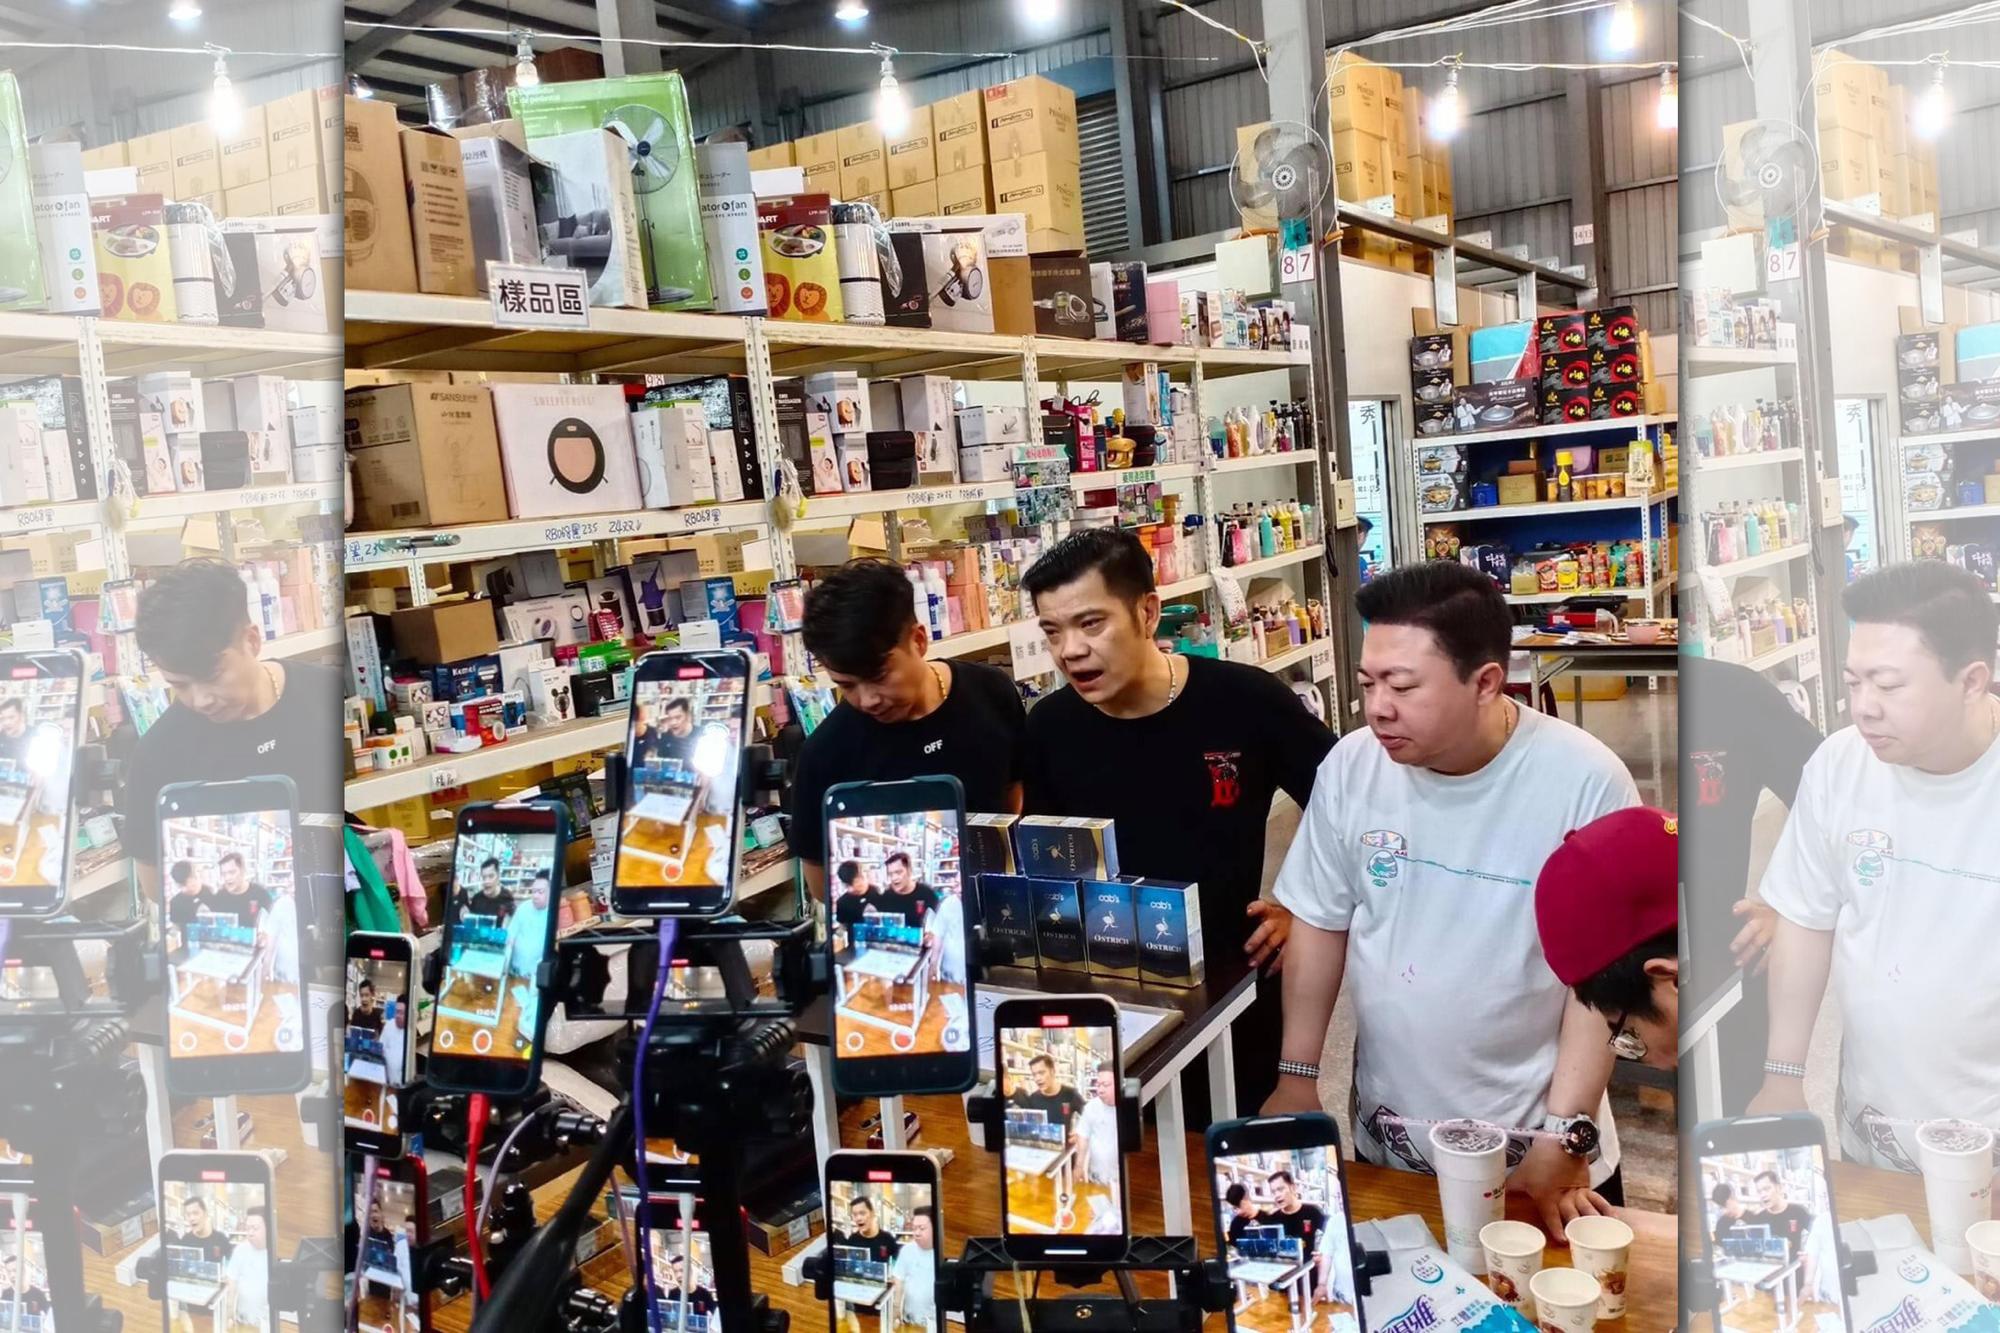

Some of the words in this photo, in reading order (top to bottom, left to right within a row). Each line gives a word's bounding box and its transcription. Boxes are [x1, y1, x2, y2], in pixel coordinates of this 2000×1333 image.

[731, 199, 747, 213] fan
[1283, 253, 1311, 275] 87
[1769, 252, 1797, 273] 87
[498, 278, 584, 316] 樣品區
[256, 739, 277, 755] OFF
[923, 739, 944, 755] OFF
[1094, 934, 1130, 946] OSTRICH
[1145, 941, 1182, 953] OSTRICH
